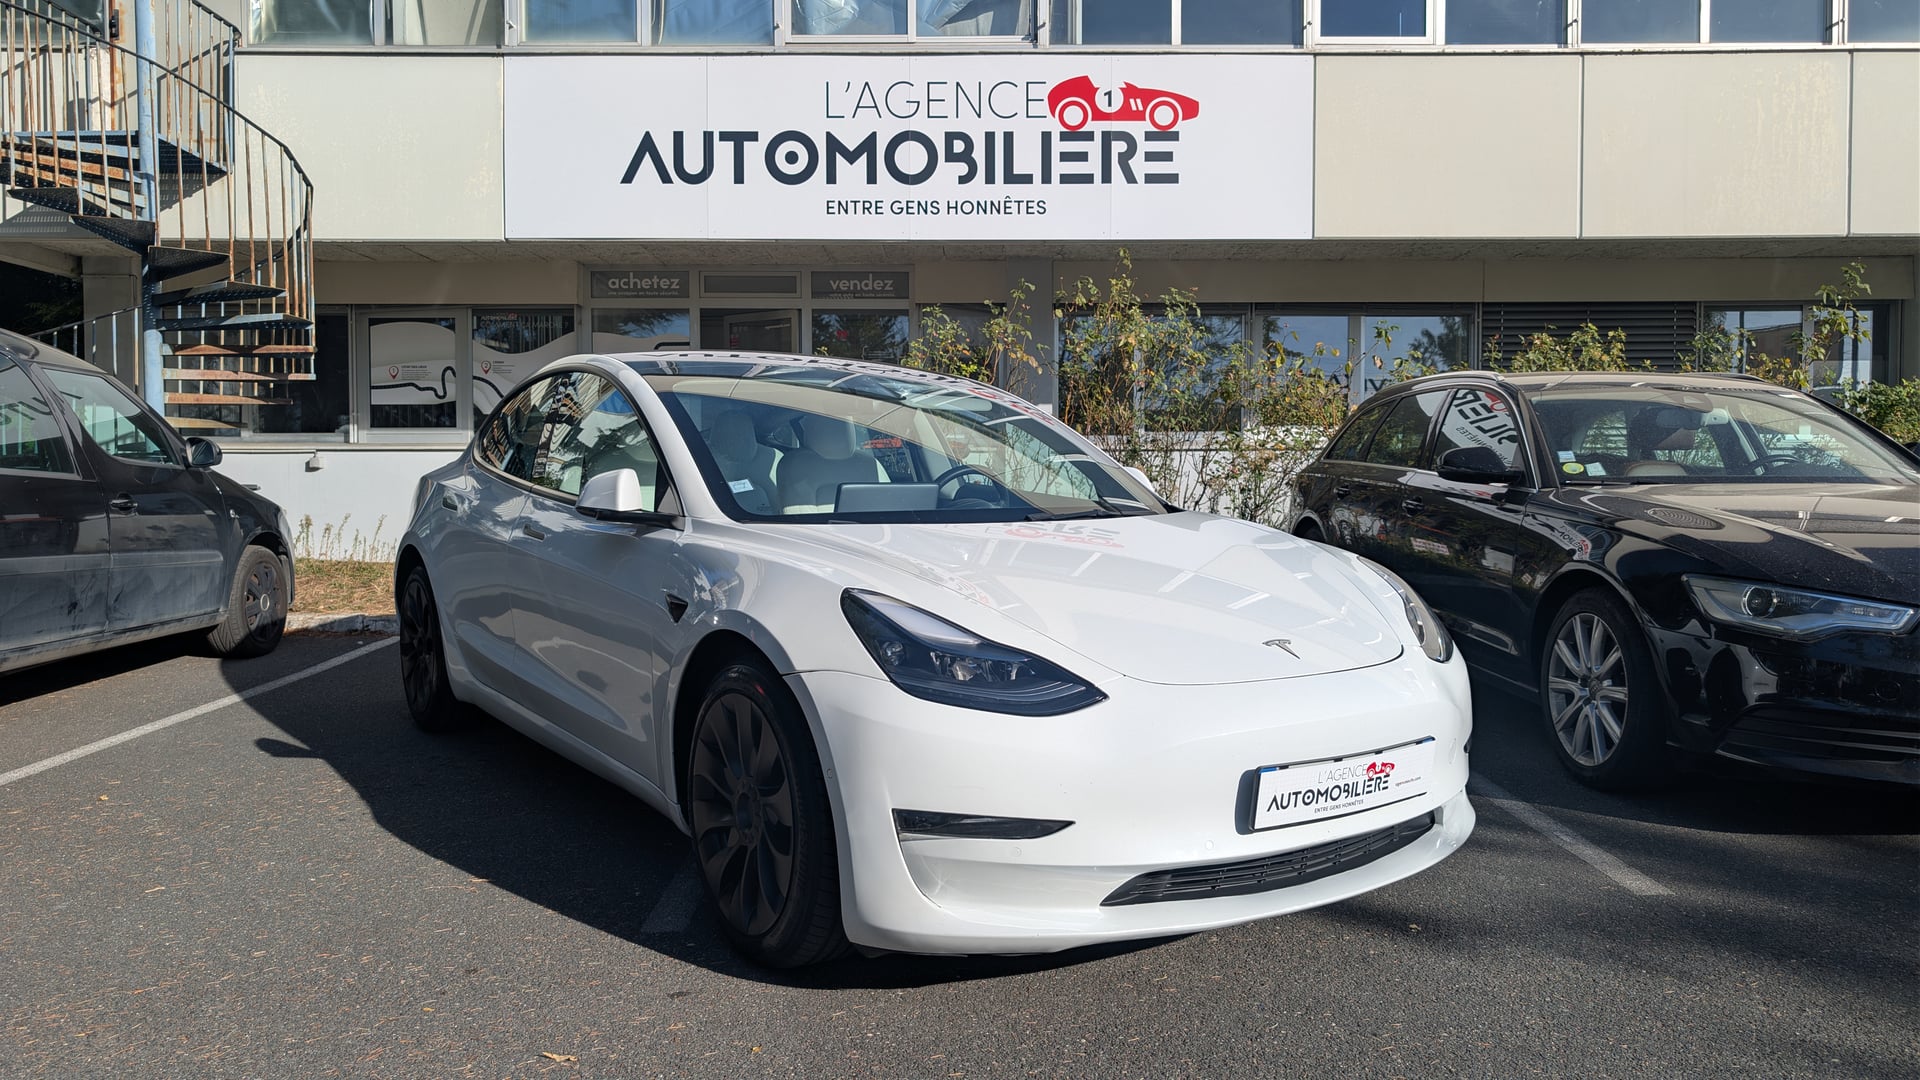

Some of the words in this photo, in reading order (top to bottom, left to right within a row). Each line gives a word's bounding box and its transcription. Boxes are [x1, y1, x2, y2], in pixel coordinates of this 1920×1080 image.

[826, 81, 1047, 119] L'AGENCE
[1103, 89, 1113, 108] 1
[826, 200, 884, 215] ENTRE
[890, 200, 940, 215] GENS
[947, 195, 1047, 215] HONNÊTES
[608, 272, 681, 290] achetez
[829, 273, 894, 291] vendez
[1318, 764, 1368, 784] L'AGENCE
